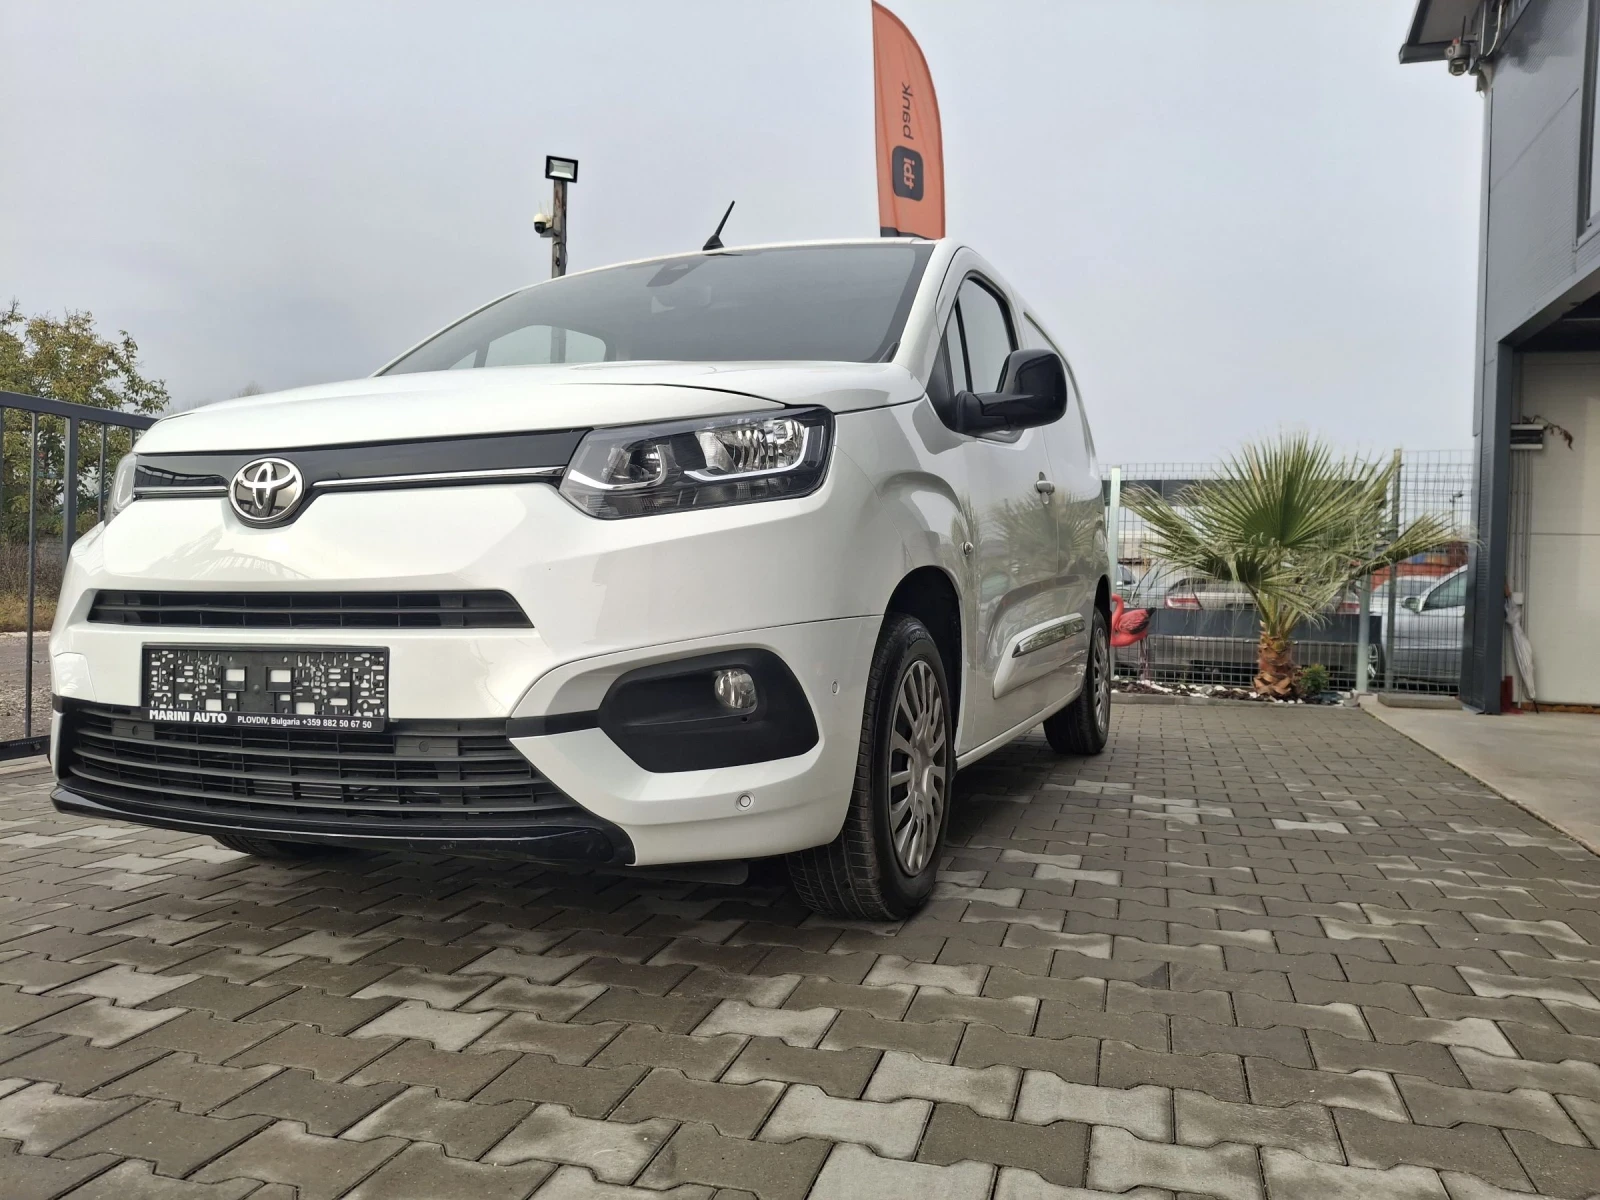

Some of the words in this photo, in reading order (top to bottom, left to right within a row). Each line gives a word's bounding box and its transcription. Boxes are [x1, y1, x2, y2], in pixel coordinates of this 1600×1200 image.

[149, 710, 190, 722] MARINI
[193, 712, 228, 724] AUTO
[237, 715, 270, 725] PLOVDIV,
[271, 717, 300, 727] Bulgaria
[302, 718, 321, 727] +359
[323, 719, 337, 727] 882
[339, 719, 349, 728] 50
[350, 720, 360, 728] 67
[362, 721, 372, 729] 50
